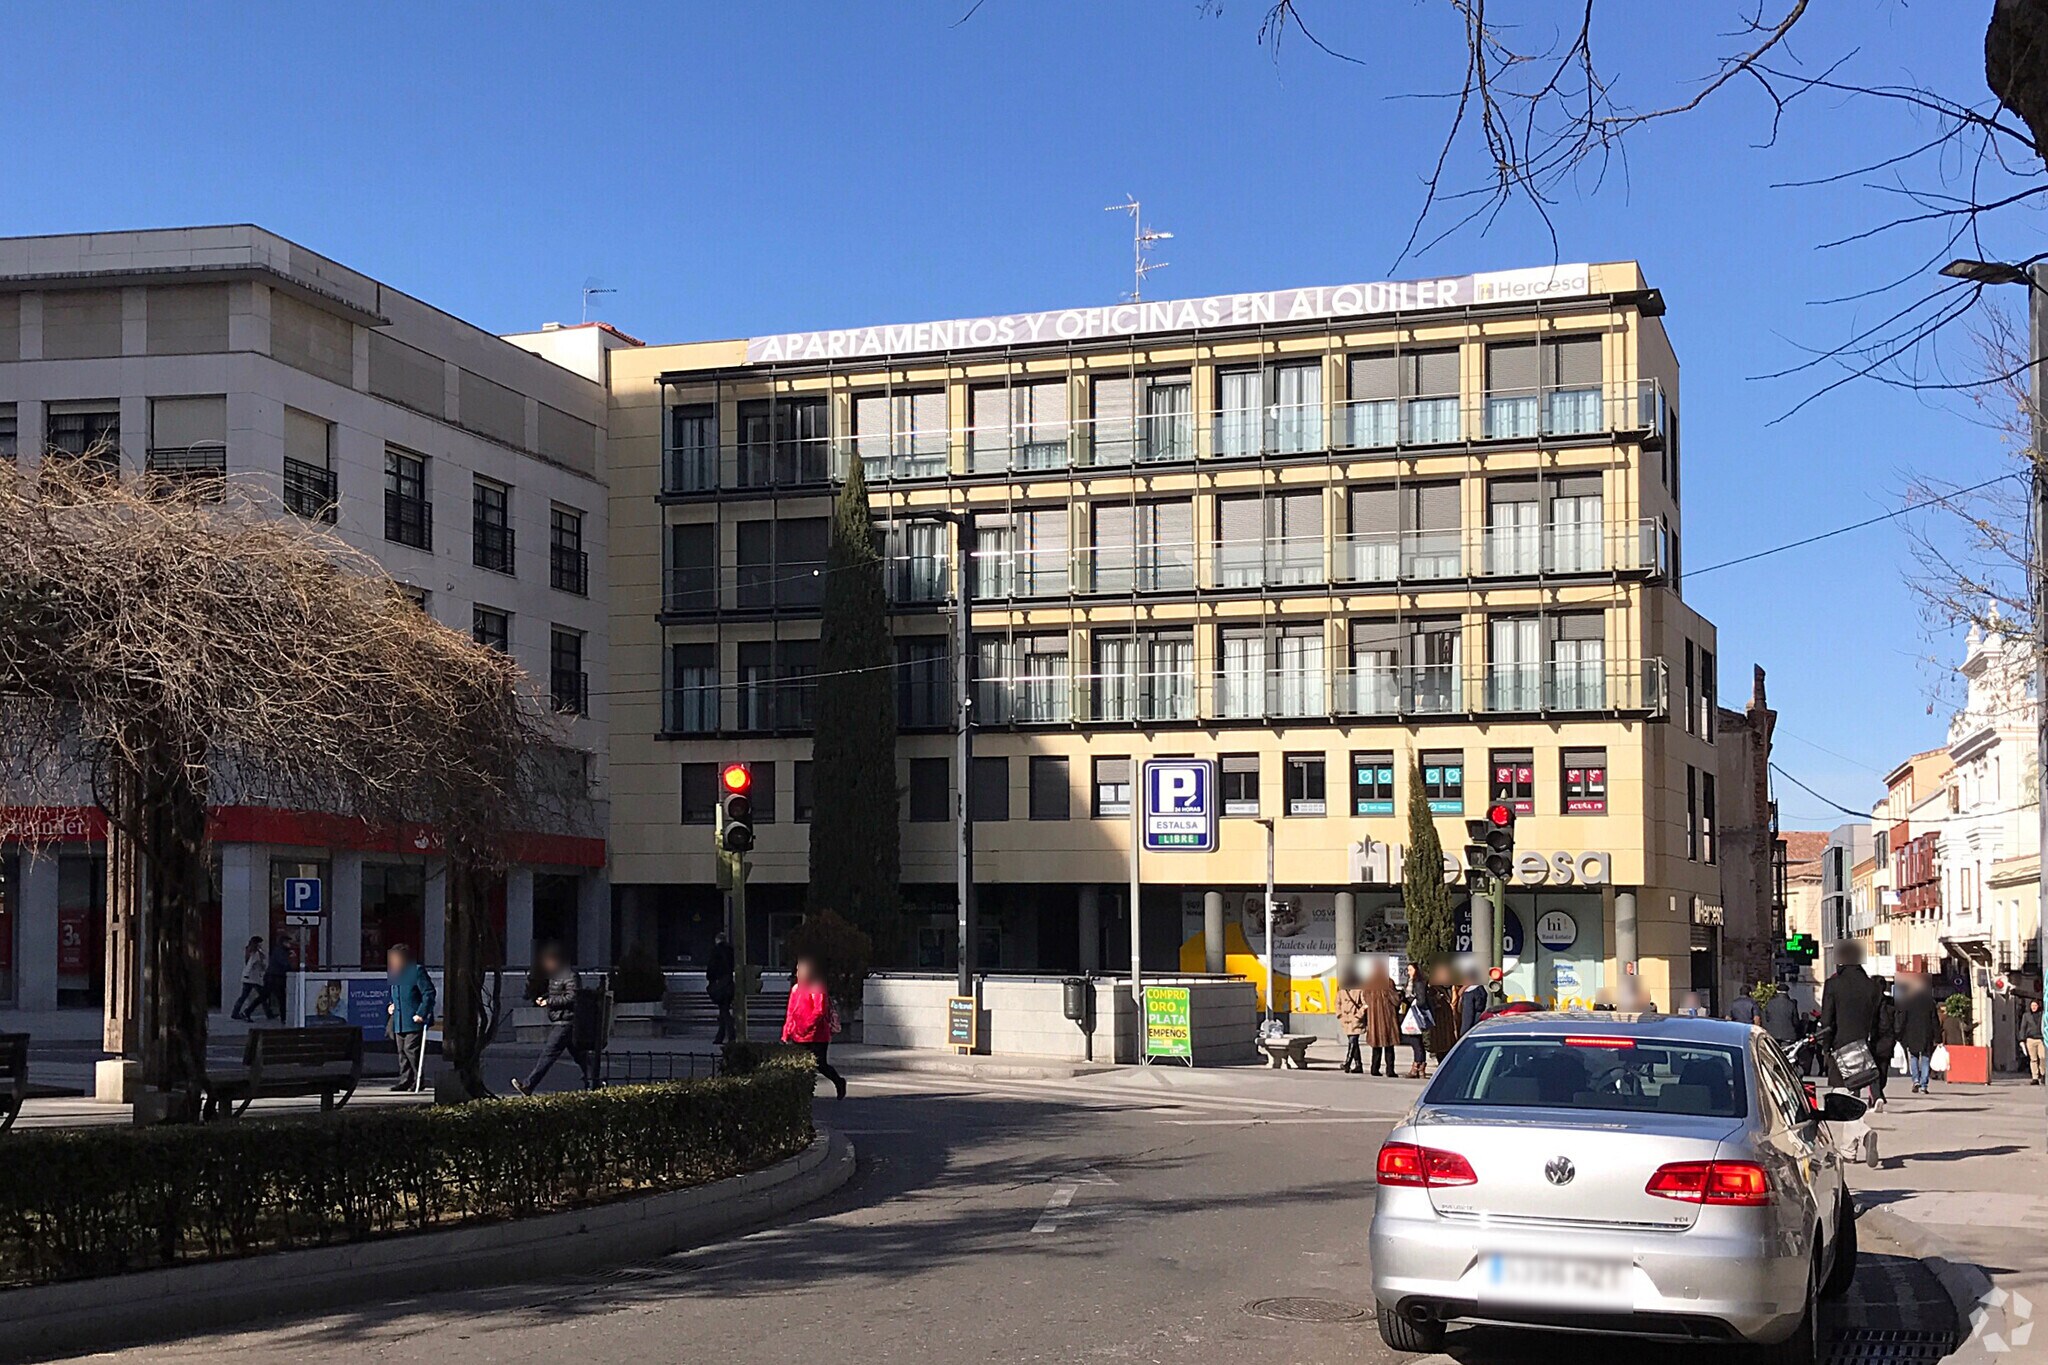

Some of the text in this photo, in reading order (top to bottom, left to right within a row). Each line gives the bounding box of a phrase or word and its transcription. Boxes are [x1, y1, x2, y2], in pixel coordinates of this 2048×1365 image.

[1498, 276, 1586, 299] Hercesa
[760, 279, 1459, 361] APARTAMENTOS Y OFICINAS EN ALQUILER
[1159, 769, 1197, 812] P
[1156, 821, 1198, 830] ESTALSA
[1163, 835, 1194, 844] LIBRE
[294, 882, 311, 908] P
[1273, 940, 1336, 951] Chalets de lujo
[351, 990, 389, 998] VITALDENT
[1147, 989, 1187, 1000] COMPRO
[1150, 1001, 1177, 1012] ORO
[1149, 1014, 1187, 1025] PLATA
[1148, 1027, 1188, 1038] EMPEÑOS
